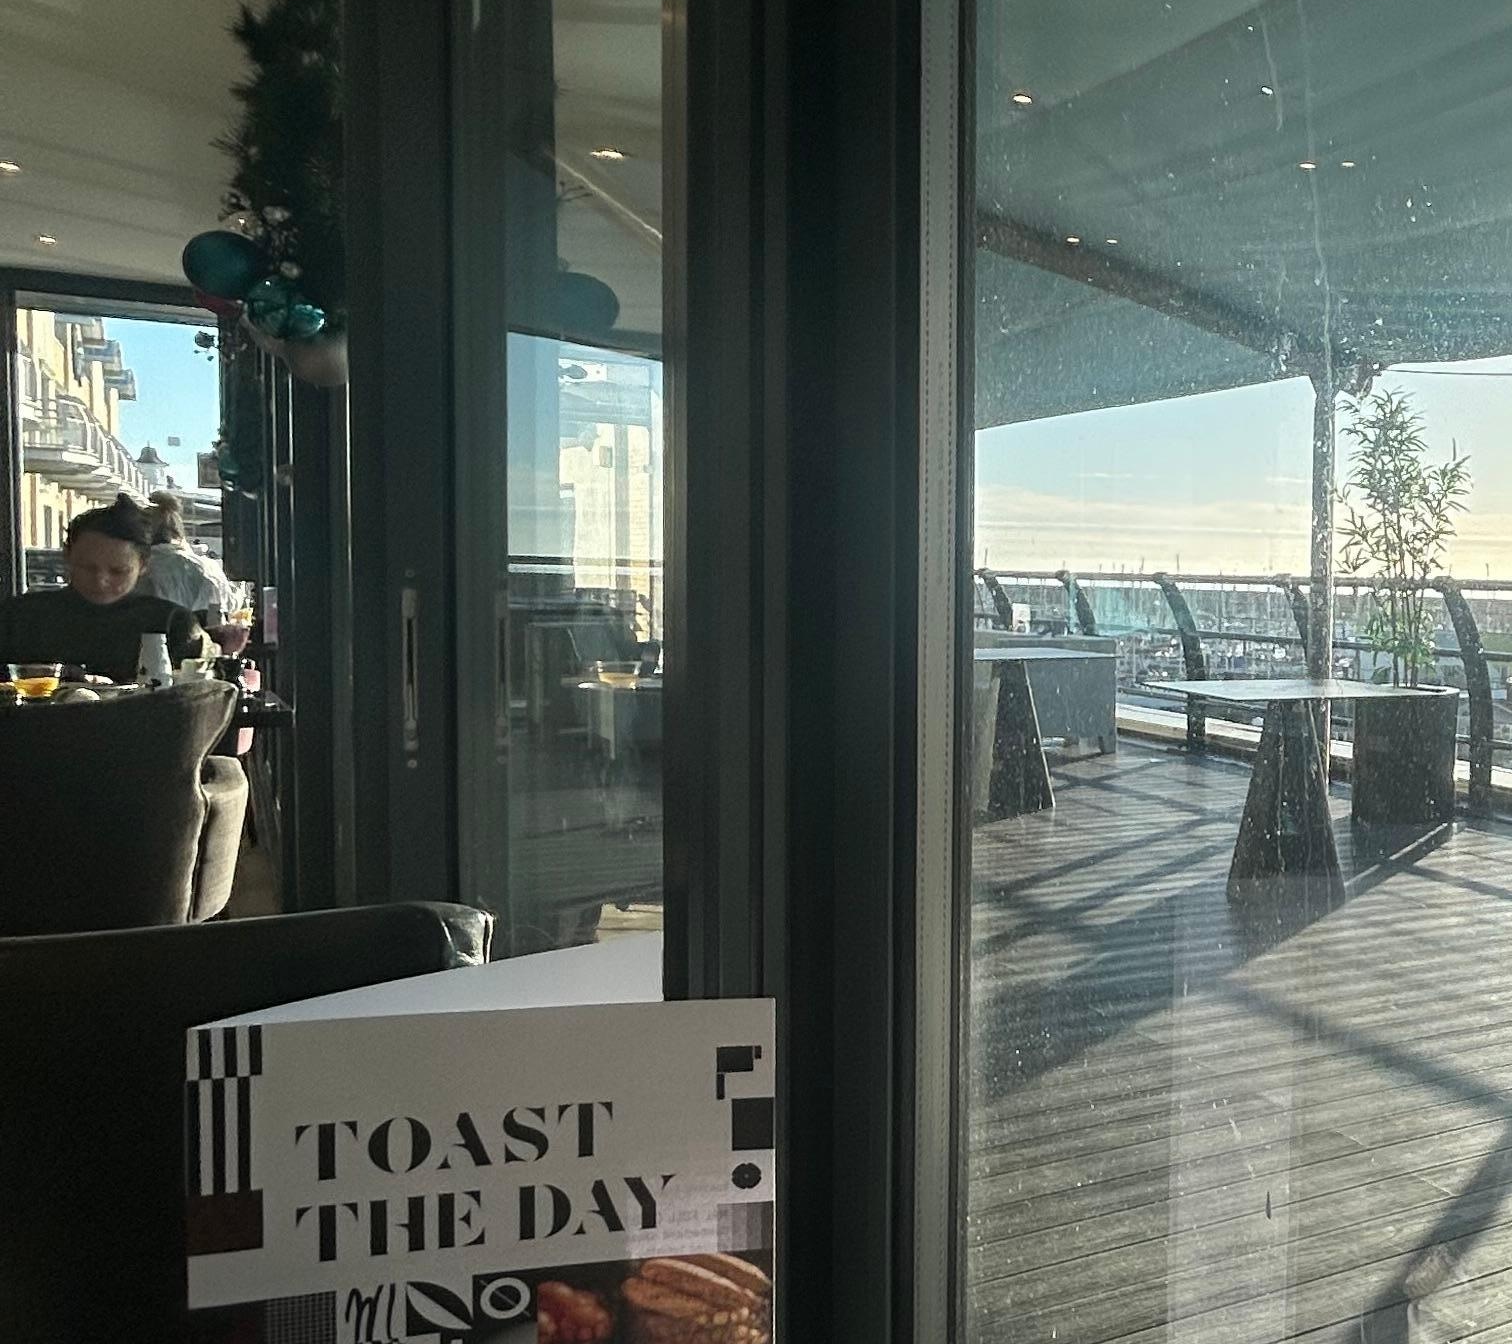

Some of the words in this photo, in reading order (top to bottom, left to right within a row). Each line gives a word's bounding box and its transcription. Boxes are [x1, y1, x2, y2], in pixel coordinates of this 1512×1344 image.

[295, 1101, 613, 1181] TOAST
[295, 1190, 486, 1262] THE
[519, 1174, 676, 1240] DAY
